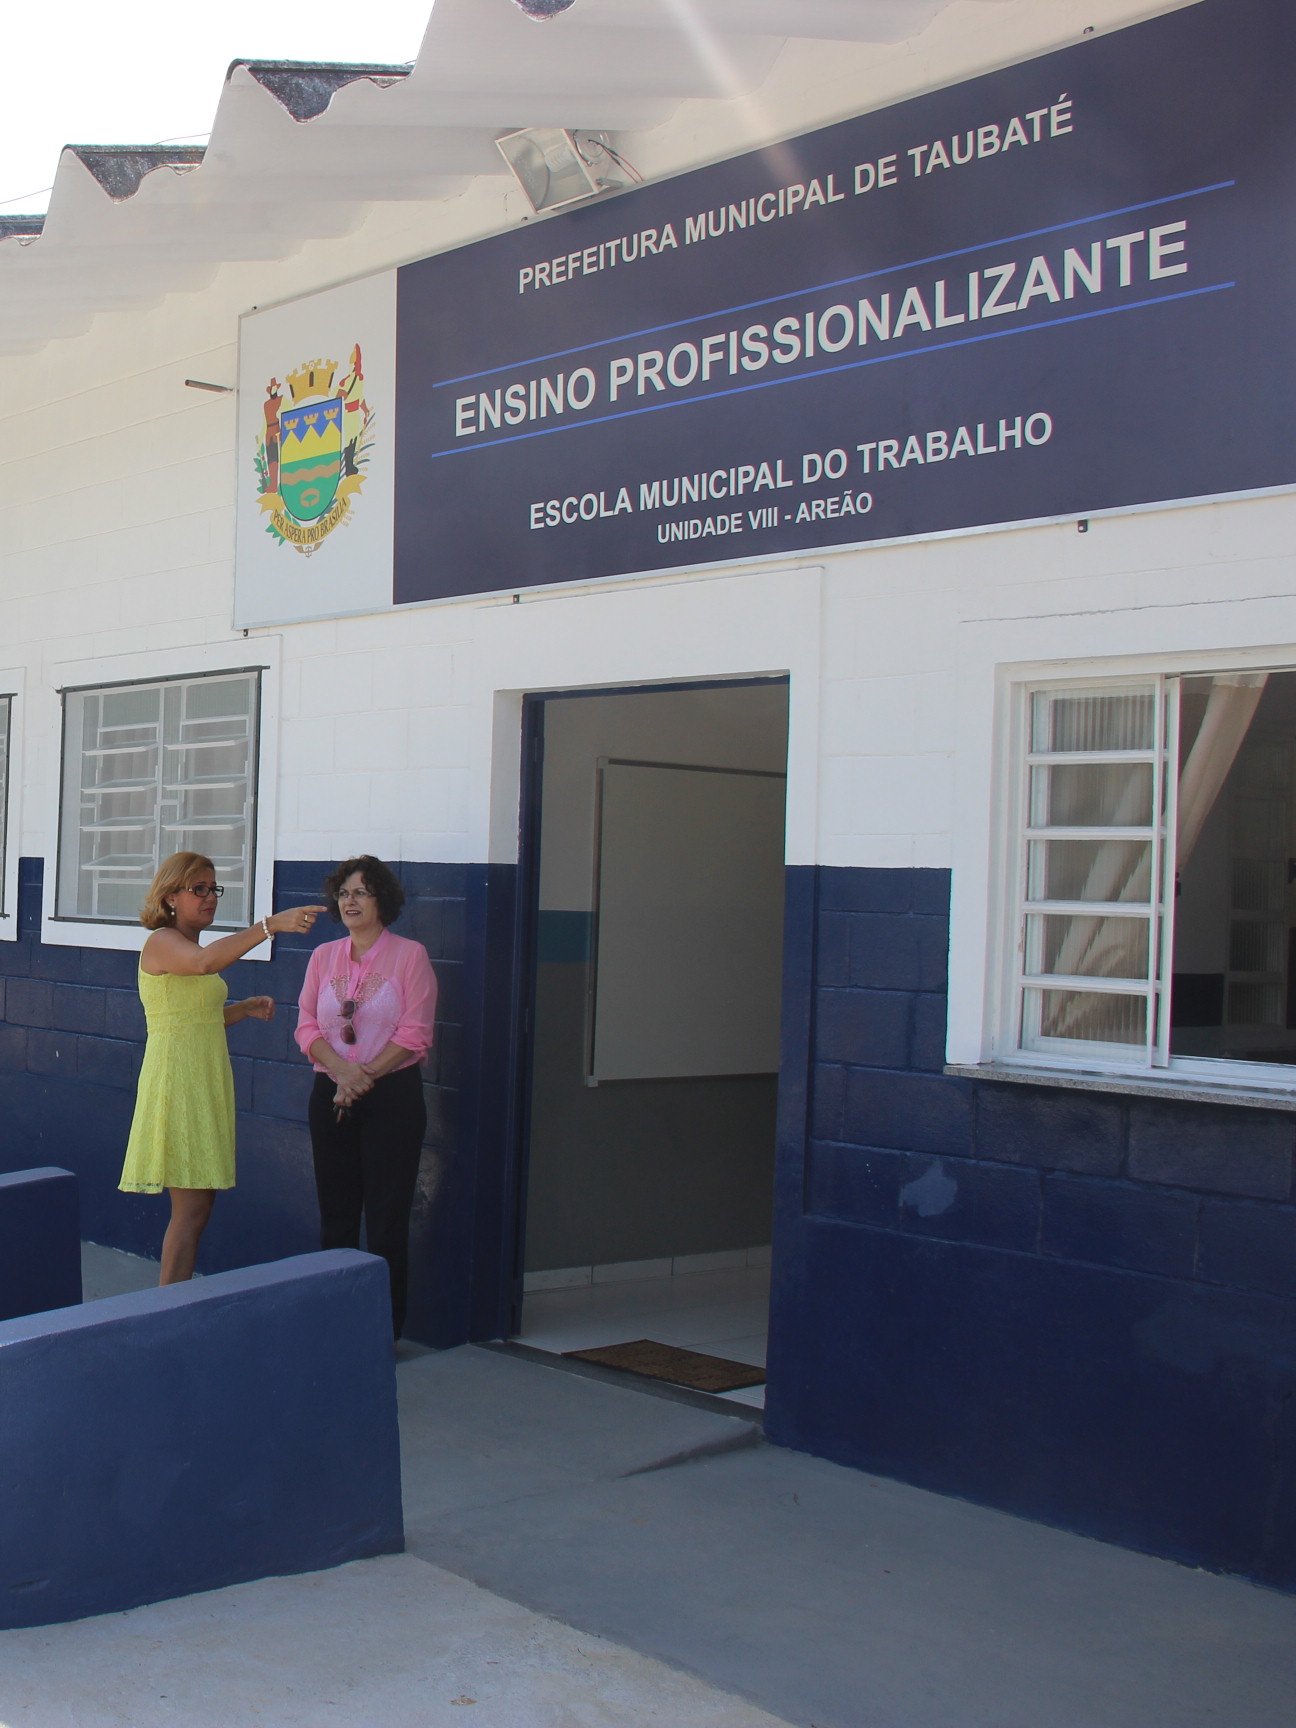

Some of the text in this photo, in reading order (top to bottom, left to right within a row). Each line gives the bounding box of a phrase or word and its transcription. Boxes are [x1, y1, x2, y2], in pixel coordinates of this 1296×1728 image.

[519, 93, 1073, 294] PREFEITURA MUNICIPAL DE TAUBATÉ
[455, 220, 1188, 437] ENSINO PROFISSIONALIZANTE
[273, 497, 347, 543] PER ASPERA PRO BRASILIA
[530, 412, 1052, 530] ESCOLA MUNICIPAL DO TRABALHO
[657, 512, 743, 544] UNIDADE
[748, 507, 778, 530] VIII
[795, 489, 873, 524] AREÃO
